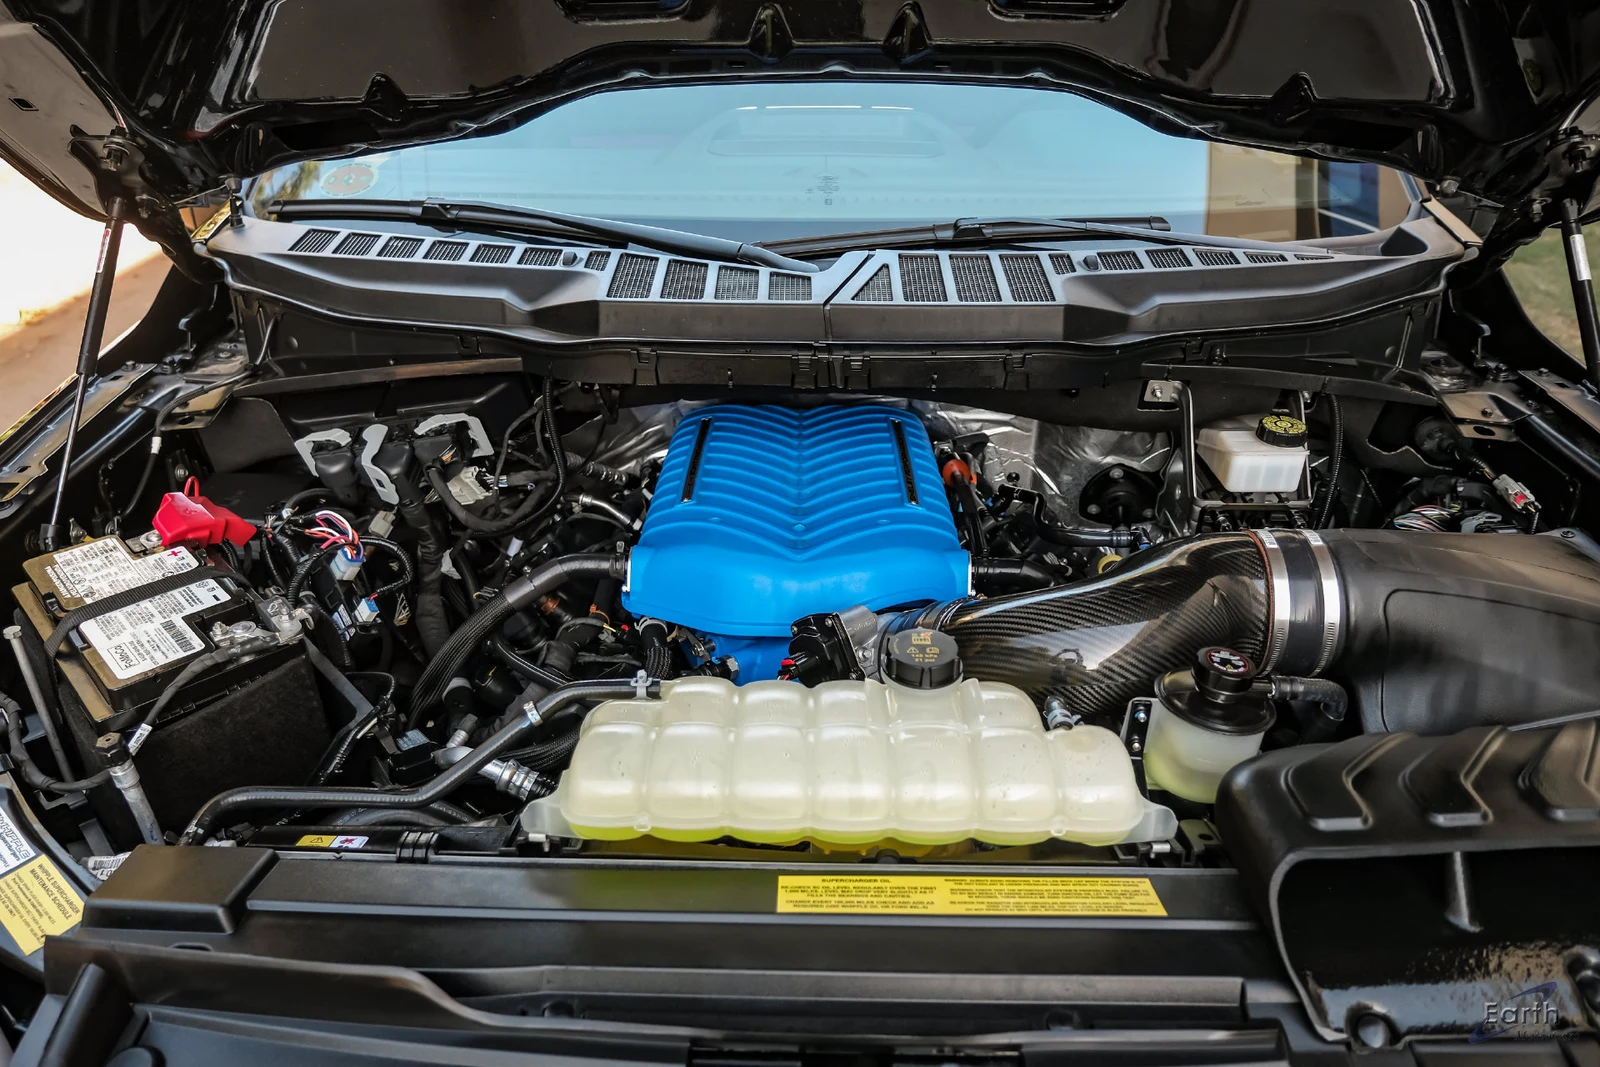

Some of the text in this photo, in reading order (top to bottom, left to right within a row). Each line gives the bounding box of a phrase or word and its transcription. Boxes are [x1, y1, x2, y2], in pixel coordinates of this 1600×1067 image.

[113, 646, 137, 670] FoMoCo
[29, 867, 55, 898] MAINTENANCE
[51, 896, 72, 919] SCHEDULE
[37, 863, 80, 914] WHIPPLE SUPERCHARGER
